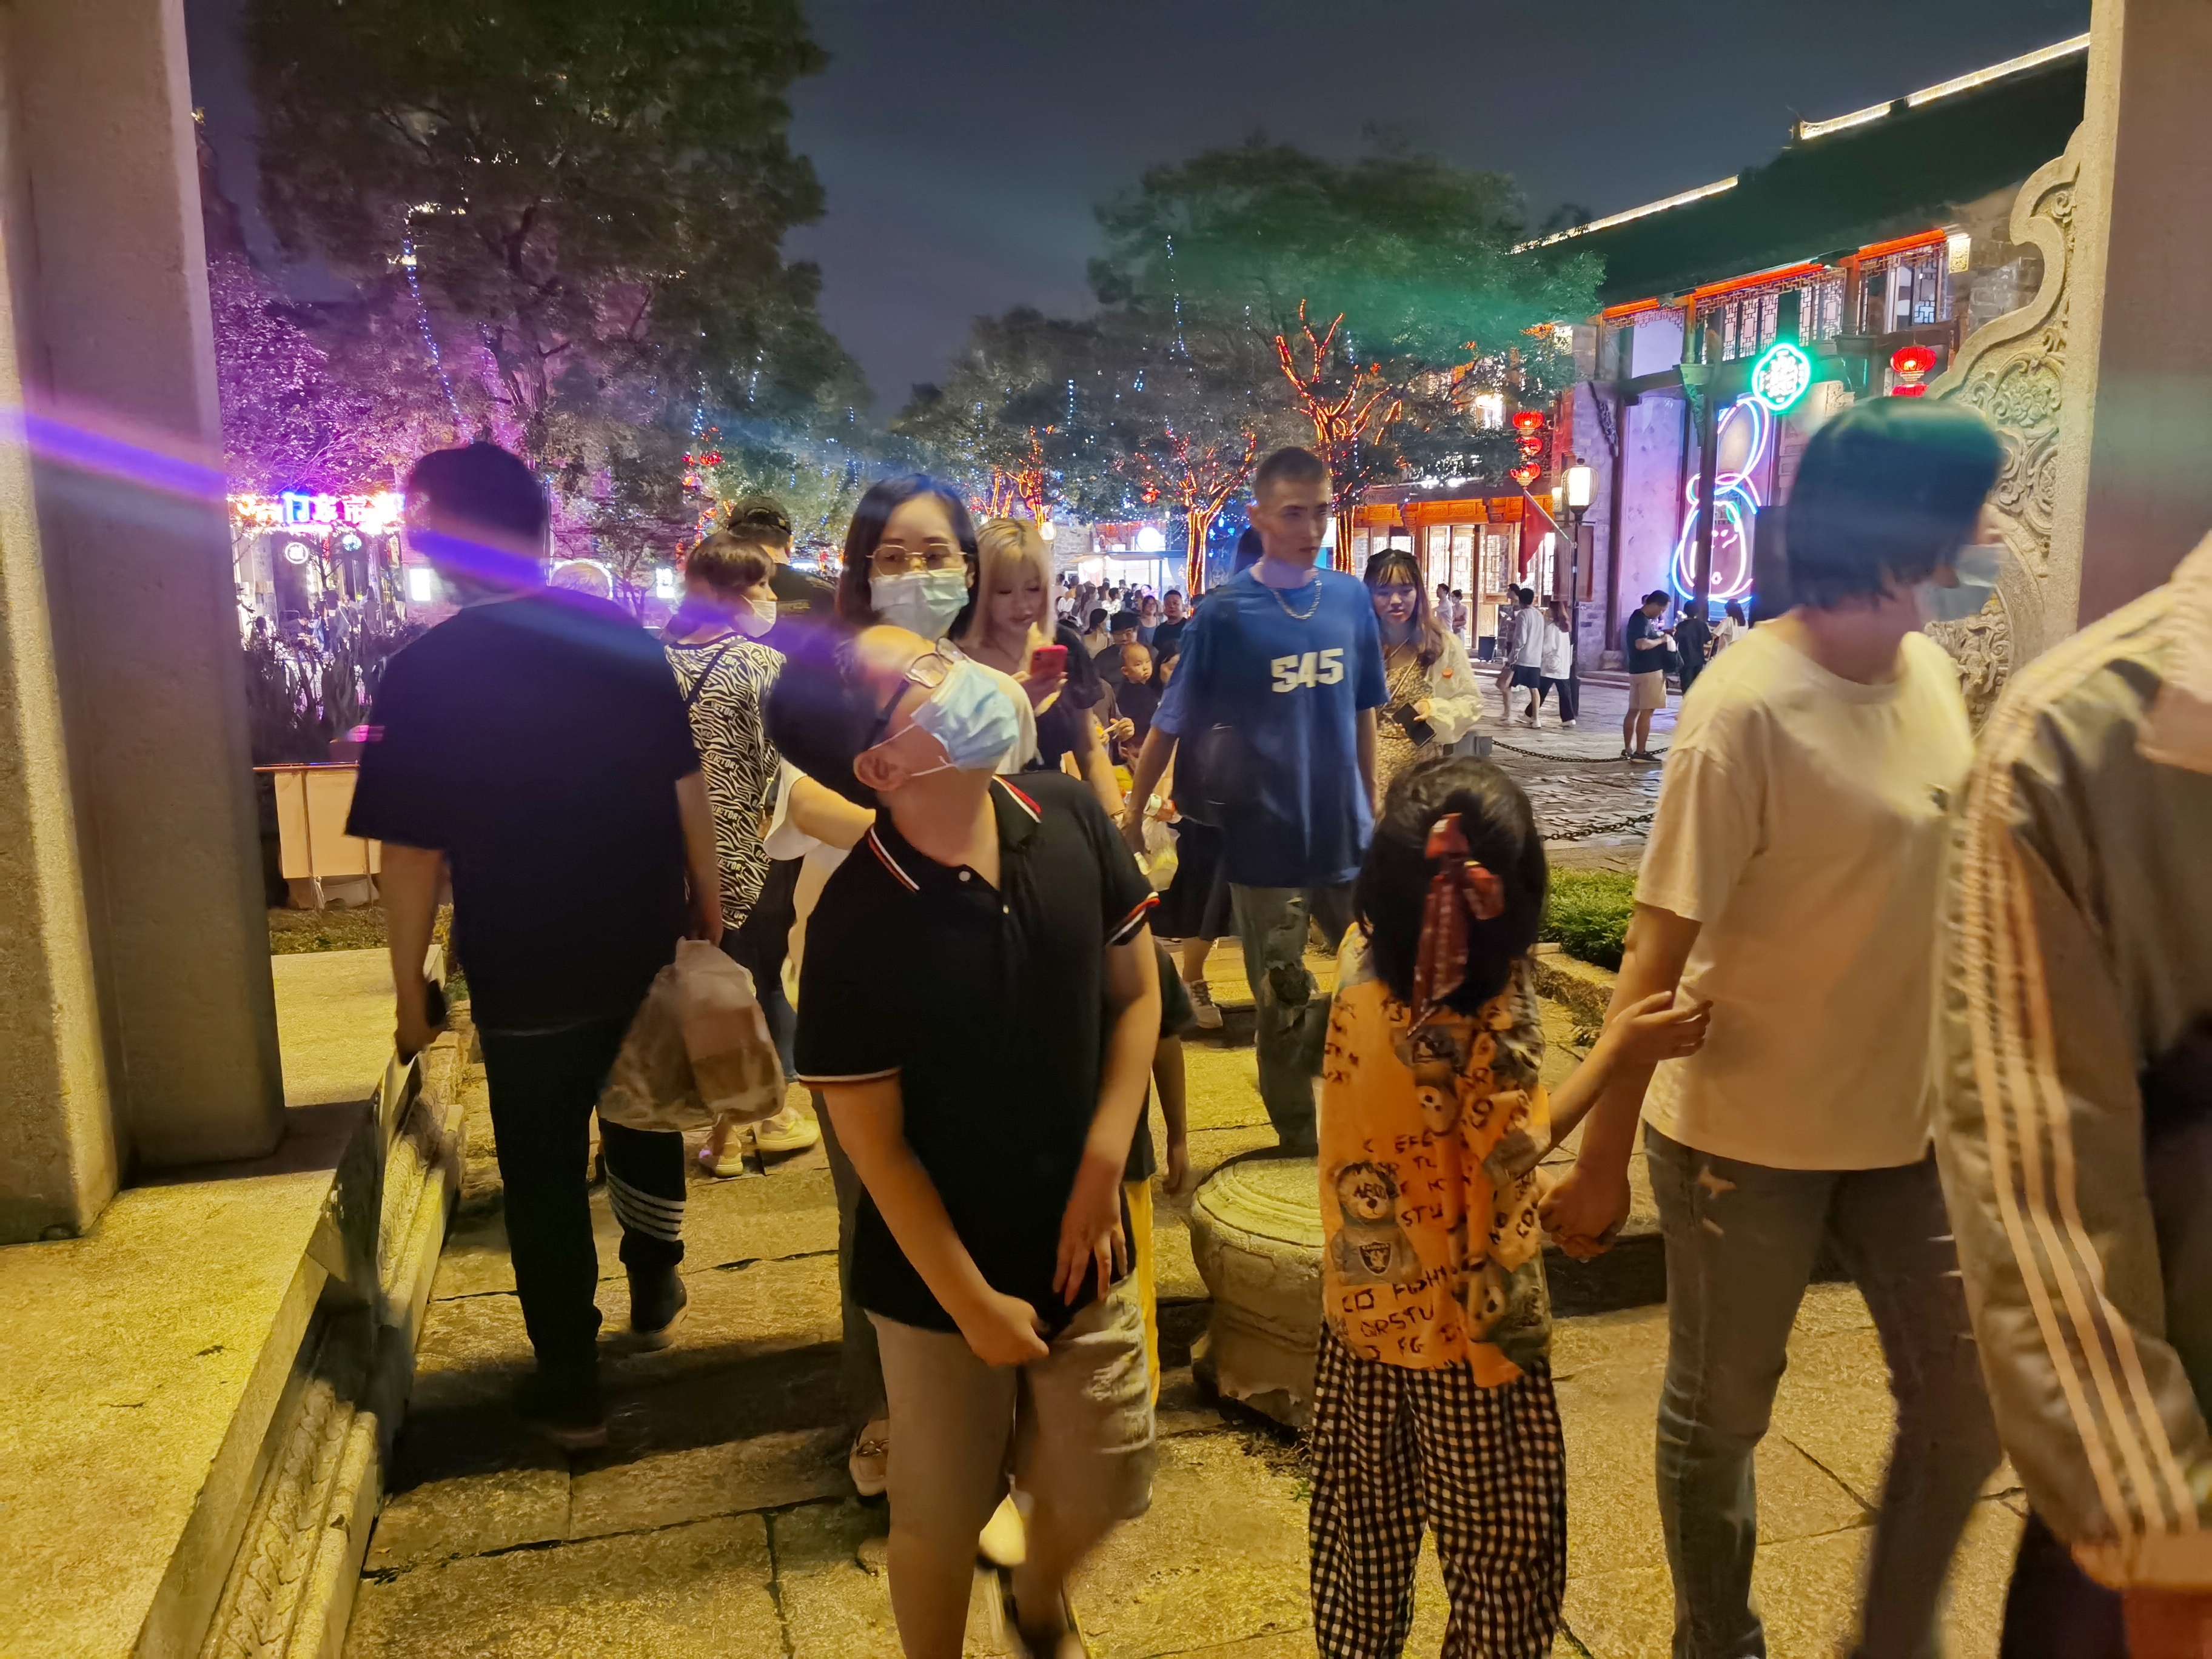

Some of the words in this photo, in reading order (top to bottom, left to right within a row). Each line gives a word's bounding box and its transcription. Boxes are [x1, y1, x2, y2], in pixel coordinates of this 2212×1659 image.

[1271, 648, 1344, 692] 545
[709, 752, 740, 772] VICTORY
[712, 805, 743, 824] VICTORY
[755, 850, 772, 864] OKEY
